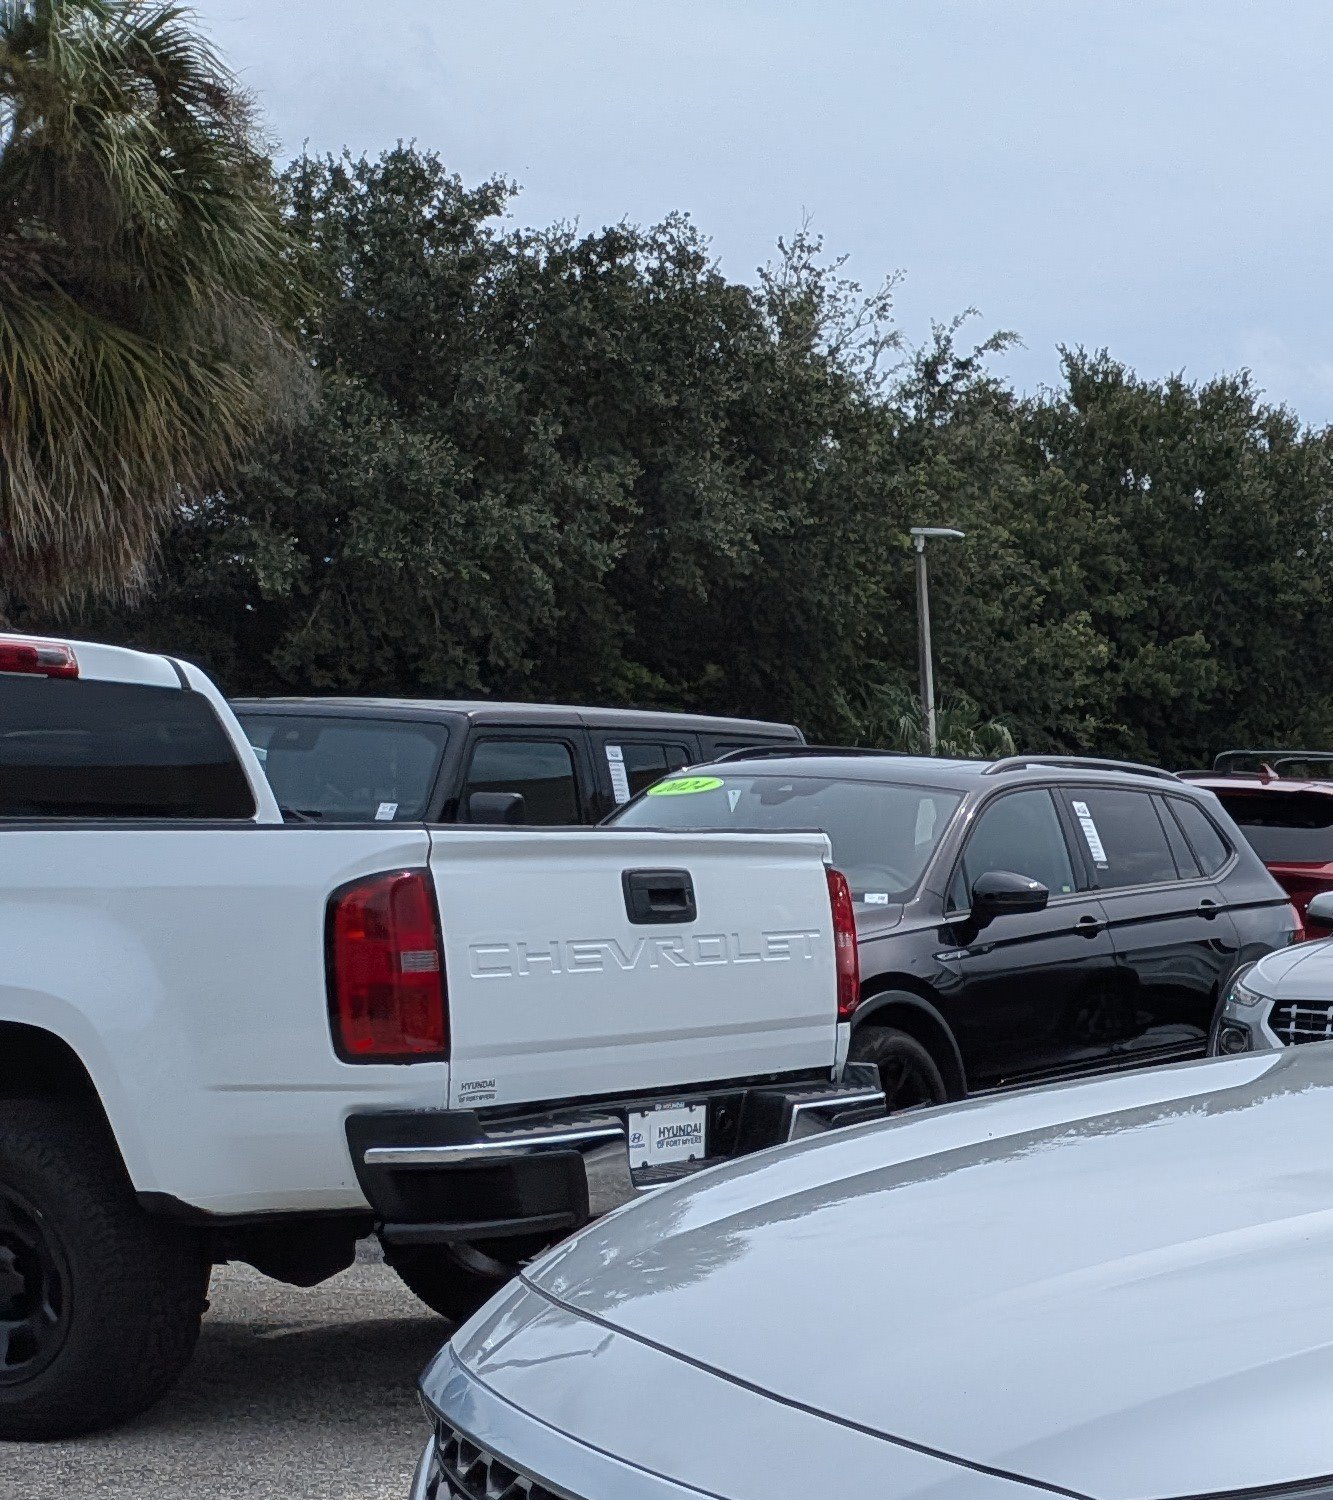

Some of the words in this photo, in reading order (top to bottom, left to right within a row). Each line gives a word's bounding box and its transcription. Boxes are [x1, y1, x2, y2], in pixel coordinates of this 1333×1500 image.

[468, 928, 821, 979] CHEVROLET
[658, 1123, 702, 1138] HYUNDAI
[665, 1138, 680, 1148] FORT
[681, 1137, 702, 1146] MYERS
